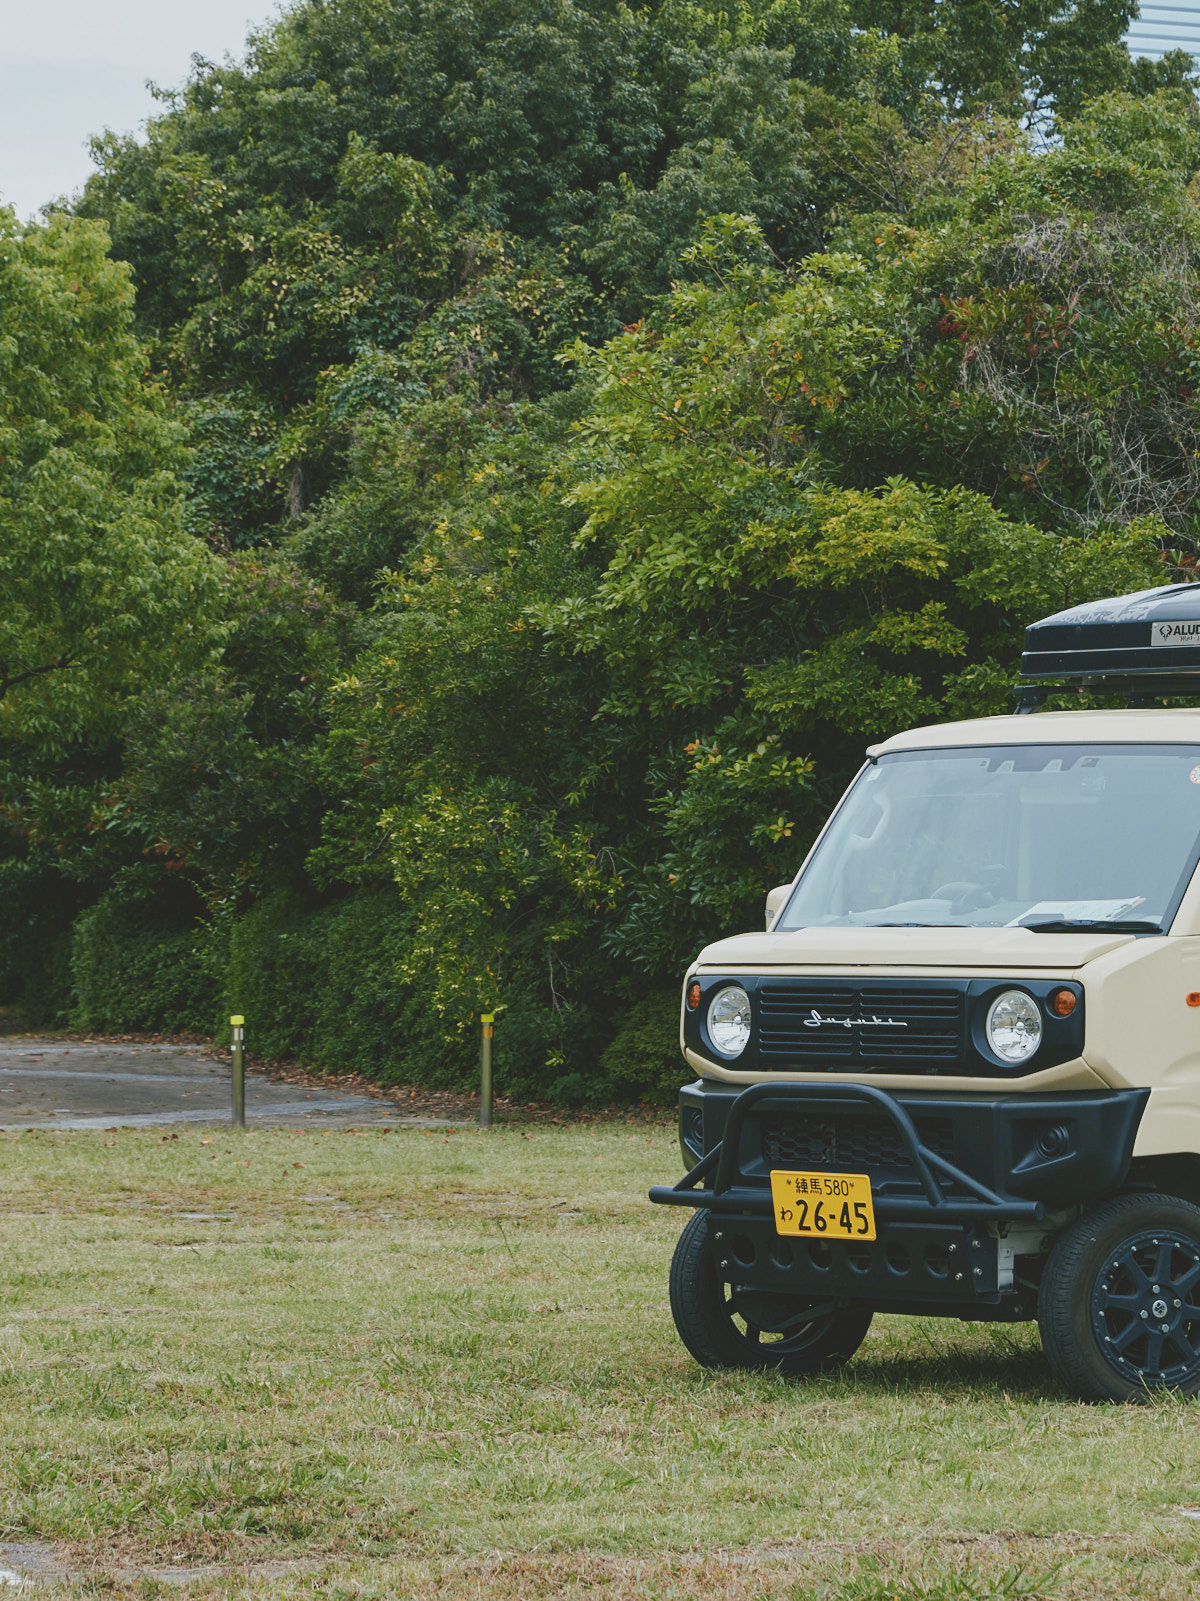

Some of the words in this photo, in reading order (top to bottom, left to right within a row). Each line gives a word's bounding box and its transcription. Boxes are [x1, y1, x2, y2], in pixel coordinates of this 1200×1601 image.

[795, 1177, 822, 1195] 練馬
[824, 1179, 849, 1196] 580
[780, 1206, 793, 1221] わ
[795, 1199, 869, 1234] 26-45
